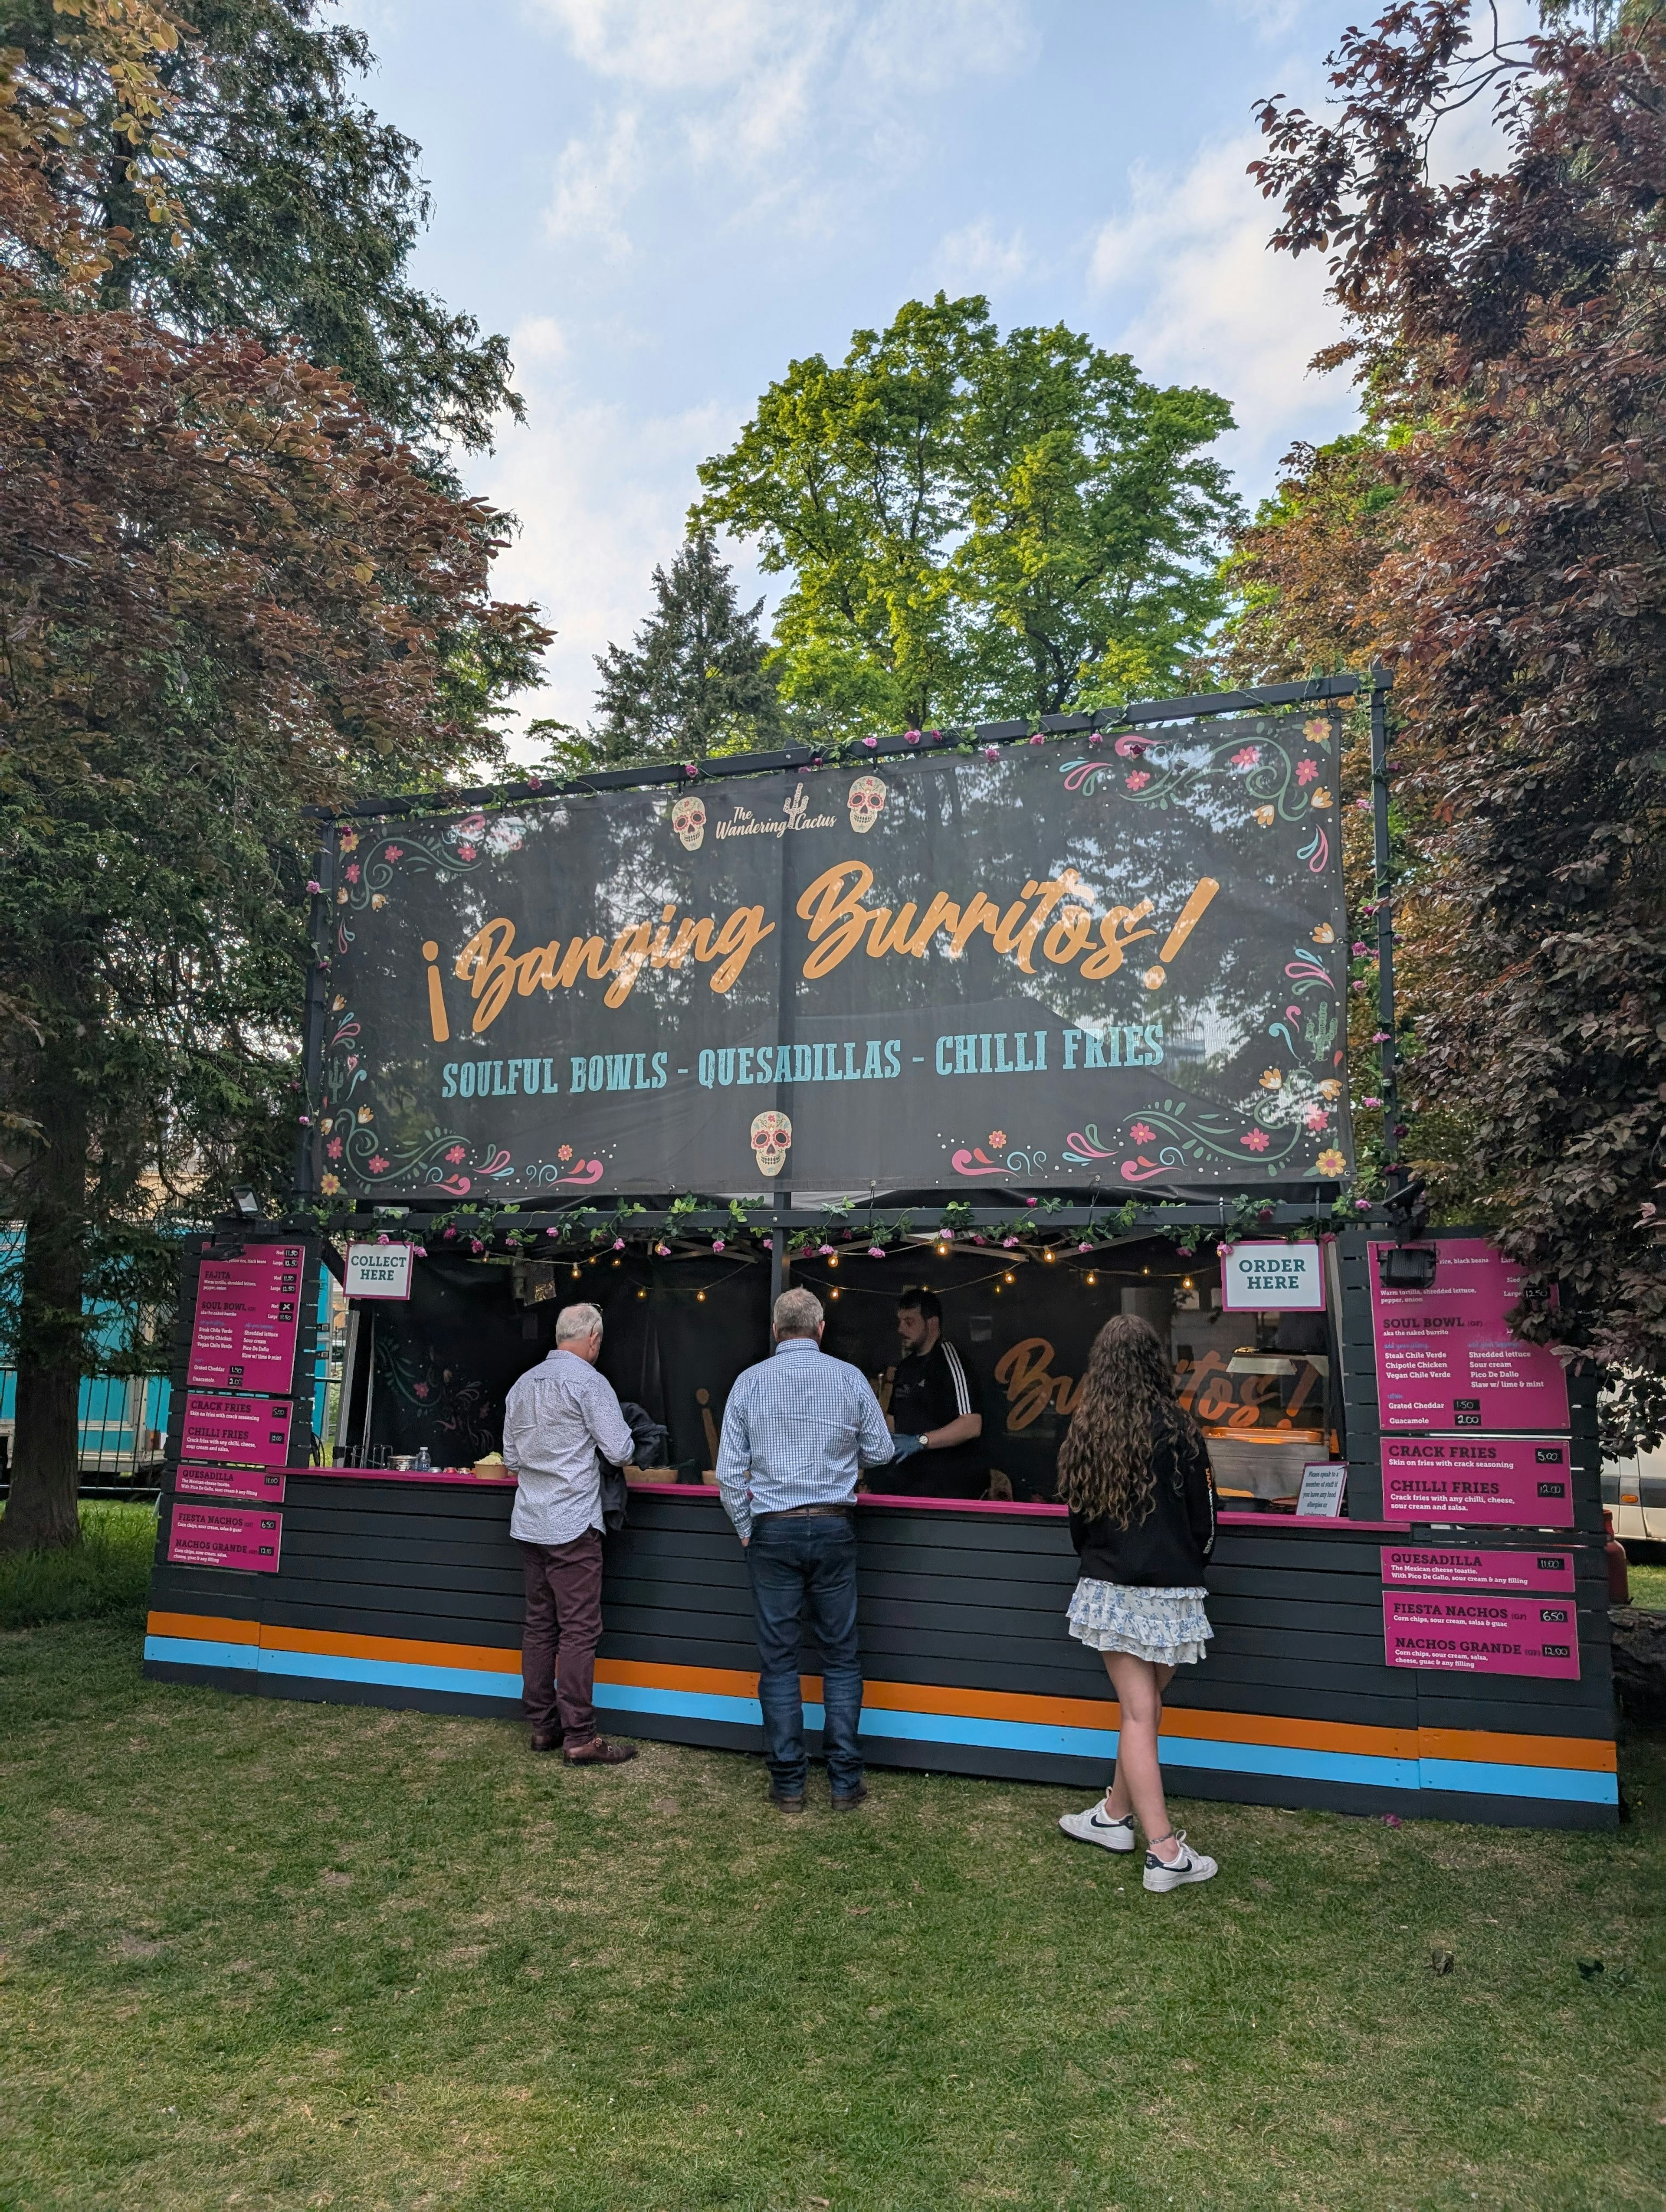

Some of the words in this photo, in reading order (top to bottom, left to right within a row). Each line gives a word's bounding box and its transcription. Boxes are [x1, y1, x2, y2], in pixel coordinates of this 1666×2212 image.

[734, 806, 753, 823] The
[716, 818, 788, 840] Wandering
[795, 813, 837, 831] Cactus
[796, 860, 1220, 990] Burritos!
[442, 1057, 558, 1098] SOULFUL
[569, 1052, 668, 1094] BOWLS
[699, 1039, 901, 1090] QUESADILLAS
[935, 1031, 1048, 1076] CHILLI
[1062, 1024, 1164, 1070] FRIES
[351, 1255, 407, 1267] COLLECT
[1239, 1259, 1305, 1273] ORDER
[205, 1271, 230, 1280] FAJITA
[360, 1269, 394, 1281] HERE
[1247, 1276, 1299, 1289] HERE
[201, 1301, 222, 1312] SOUL
[223, 1302, 246, 1311] BOWL
[1384, 1318, 1420, 1328] SOUL
[1423, 1317, 1465, 1328] BOWL
[191, 1400, 223, 1411] CRACK
[224, 1403, 251, 1413] FRIES
[188, 1427, 220, 1438] CHILLI
[222, 1429, 249, 1440] FRIES
[1388, 1446, 1445, 1457] CRACK
[1449, 1446, 1497, 1459] FRIES
[1476, 1461, 1514, 1469] seasoning
[182, 1469, 233, 1481] QUESADILLA
[1391, 1480, 1447, 1492] CHILLI
[1452, 1481, 1499, 1494] FRIES
[178, 1513, 206, 1523] FIESTA
[207, 1515, 243, 1526] NACHOS
[175, 1539, 210, 1550] NACHOS
[212, 1543, 247, 1553] GRANDE
[1391, 1553, 1482, 1566] QUESADILLA
[1391, 1565, 1404, 1573] The
[1394, 1603, 1442, 1615] FIESTA
[1445, 1606, 1508, 1619] NACHOS
[1395, 1637, 1456, 1651] NACHOS
[1459, 1641, 1522, 1655] GRANDE
[1455, 1660, 1475, 1669] filling
